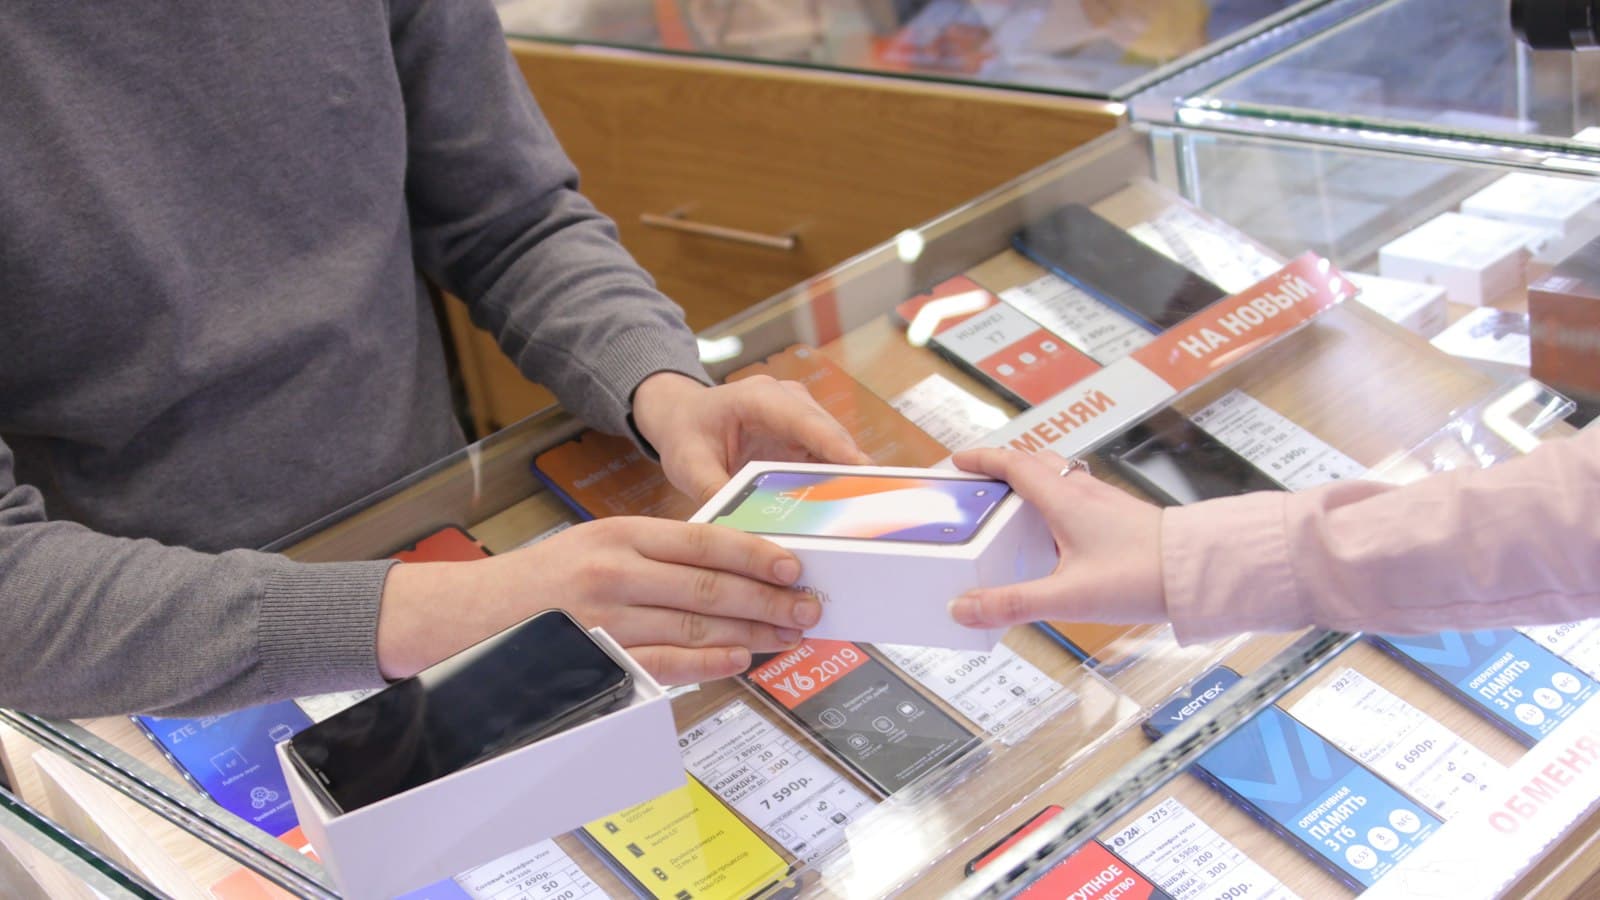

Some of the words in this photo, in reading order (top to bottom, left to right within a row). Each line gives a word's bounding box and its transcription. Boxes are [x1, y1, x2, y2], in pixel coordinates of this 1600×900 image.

[956, 312, 1003, 341] HUAWEI
[1178, 328, 1230, 359] НА
[1217, 273, 1318, 338] НОВЫЙ
[1003, 388, 1118, 454] МЕНЯЙ
[757, 643, 816, 683] HUAWEI
[773, 672, 816, 699] Y6
[812, 646, 860, 683] 2019
[1468, 651, 1515, 689] ОПЕРАТИВНАЯ
[1478, 659, 1531, 700] ПАМЯТЬ
[1170, 682, 1224, 721] VERTEX
[1494, 697, 1510, 710] 3
[168, 723, 197, 745] ZTE
[713, 765, 749, 791] КЭШБЭК
[757, 750, 774, 763] 20
[1395, 760, 1406, 772] 6
[1403, 738, 1437, 766] 690р.
[723, 774, 758, 798] СКИДКА
[768, 758, 789, 774] 300
[760, 799, 771, 811] 7
[772, 776, 813, 802] 590р.
[1148, 807, 1168, 824] 275
[1298, 785, 1351, 829] ОПЕРАТИВНАЯ
[1308, 795, 1368, 841] ПАМЯТЬ
[1124, 827, 1139, 841] 24
[1324, 837, 1341, 852] 3
[1194, 851, 1213, 868] 200
[516, 883, 523, 891] 7
[525, 871, 552, 888] 690р.
[541, 880, 559, 893] 50
[551, 890, 575, 900] 00
[1171, 878, 1198, 898] КИДКА
[1206, 862, 1228, 879] 300
[1215, 883, 1253, 900] 90р.
